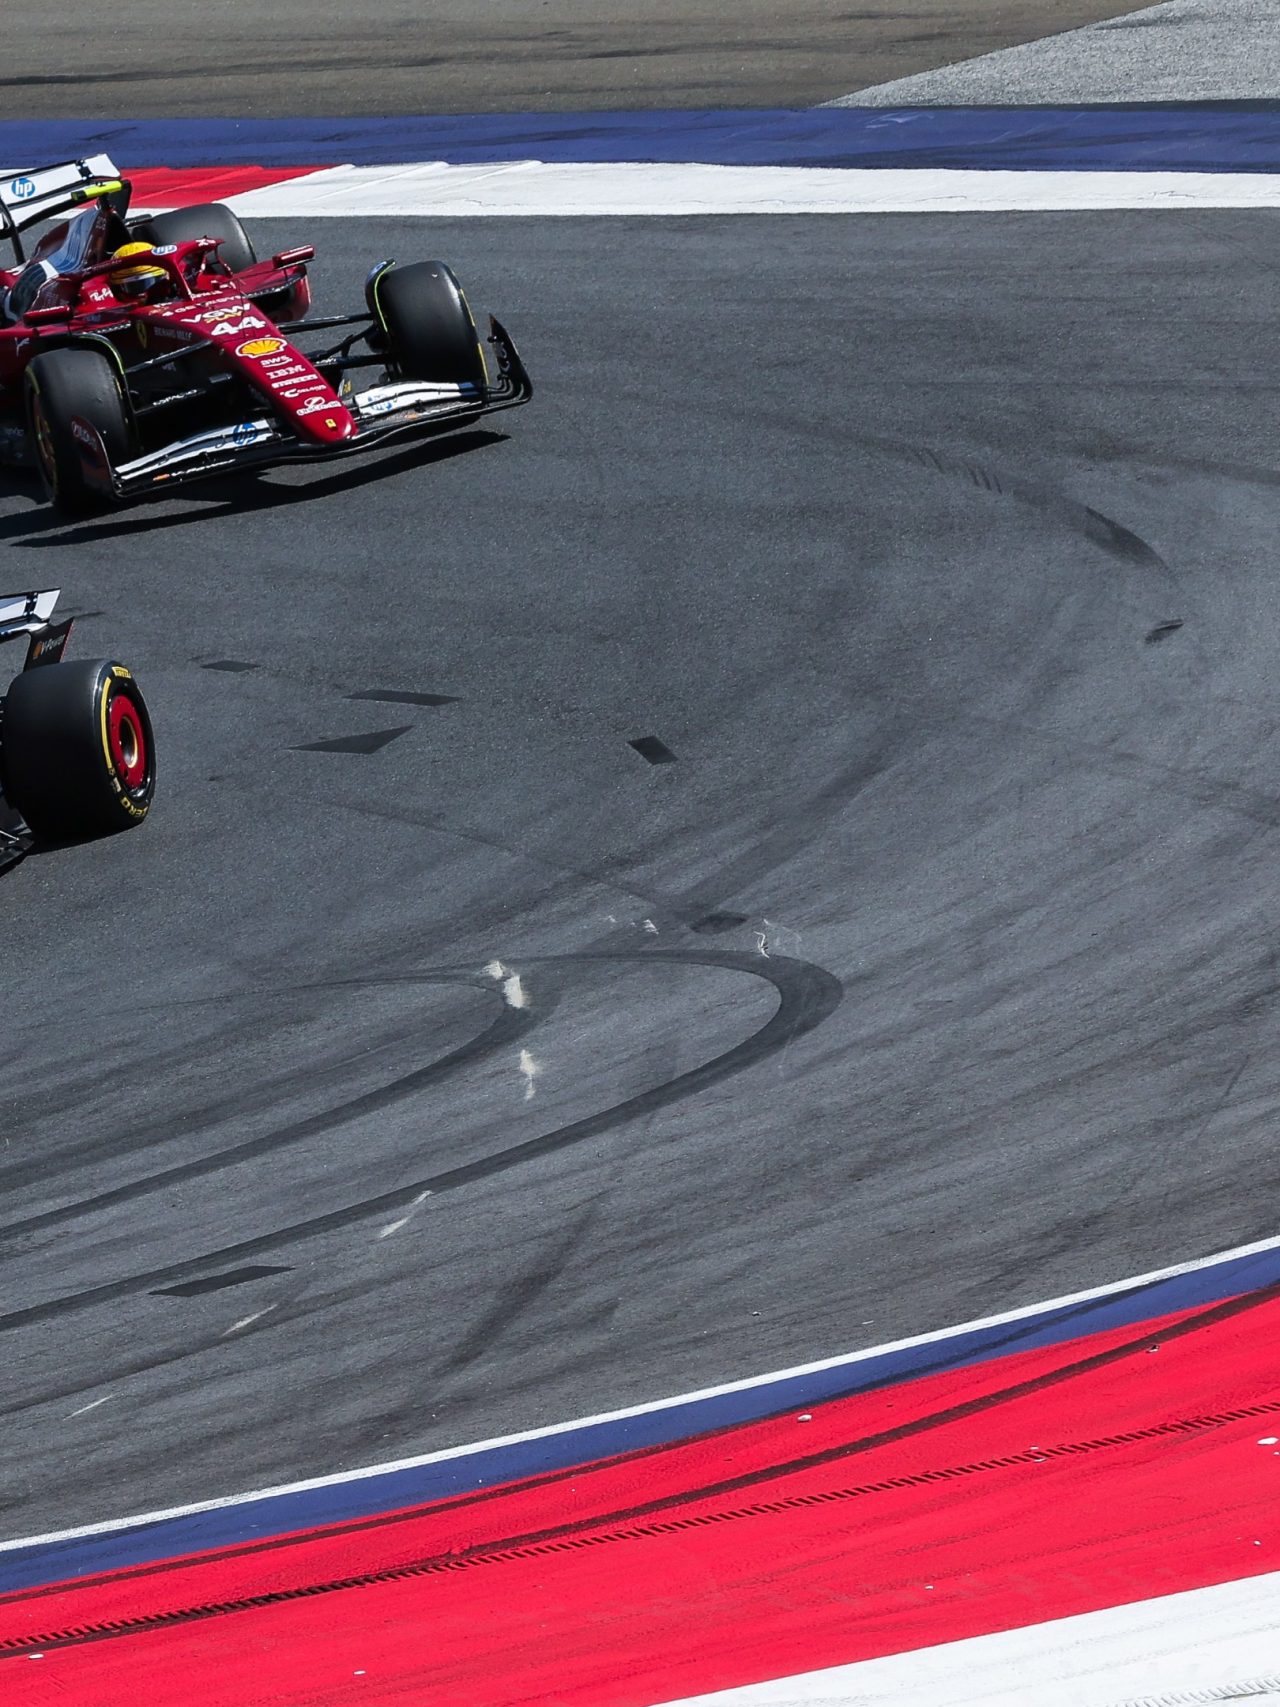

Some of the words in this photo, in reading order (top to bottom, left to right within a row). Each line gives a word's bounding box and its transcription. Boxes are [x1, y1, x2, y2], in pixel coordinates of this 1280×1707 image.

[14, 178, 34, 198] hp
[181, 303, 250, 323] VGW
[211, 316, 266, 336] 44
[266, 364, 306, 379] IBM
